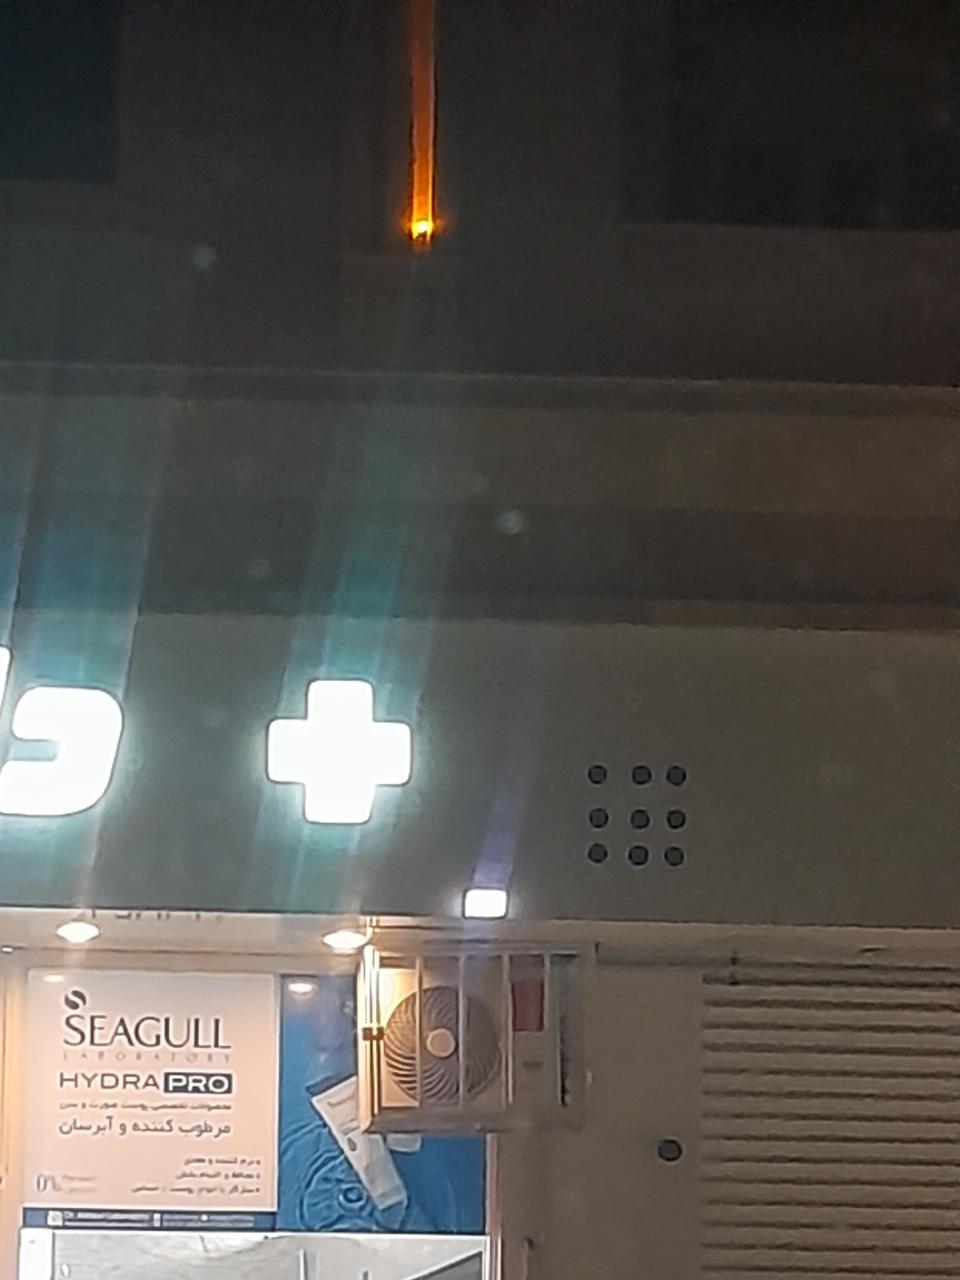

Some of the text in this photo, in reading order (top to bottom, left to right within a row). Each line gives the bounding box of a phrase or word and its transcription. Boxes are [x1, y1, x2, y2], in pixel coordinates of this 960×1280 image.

[63, 1014, 232, 1050] SEAGULL
[59, 1072, 229, 1093] HYDRA PRO
[59, 1115, 231, 1138] مرطوب کننده و آبرسان
